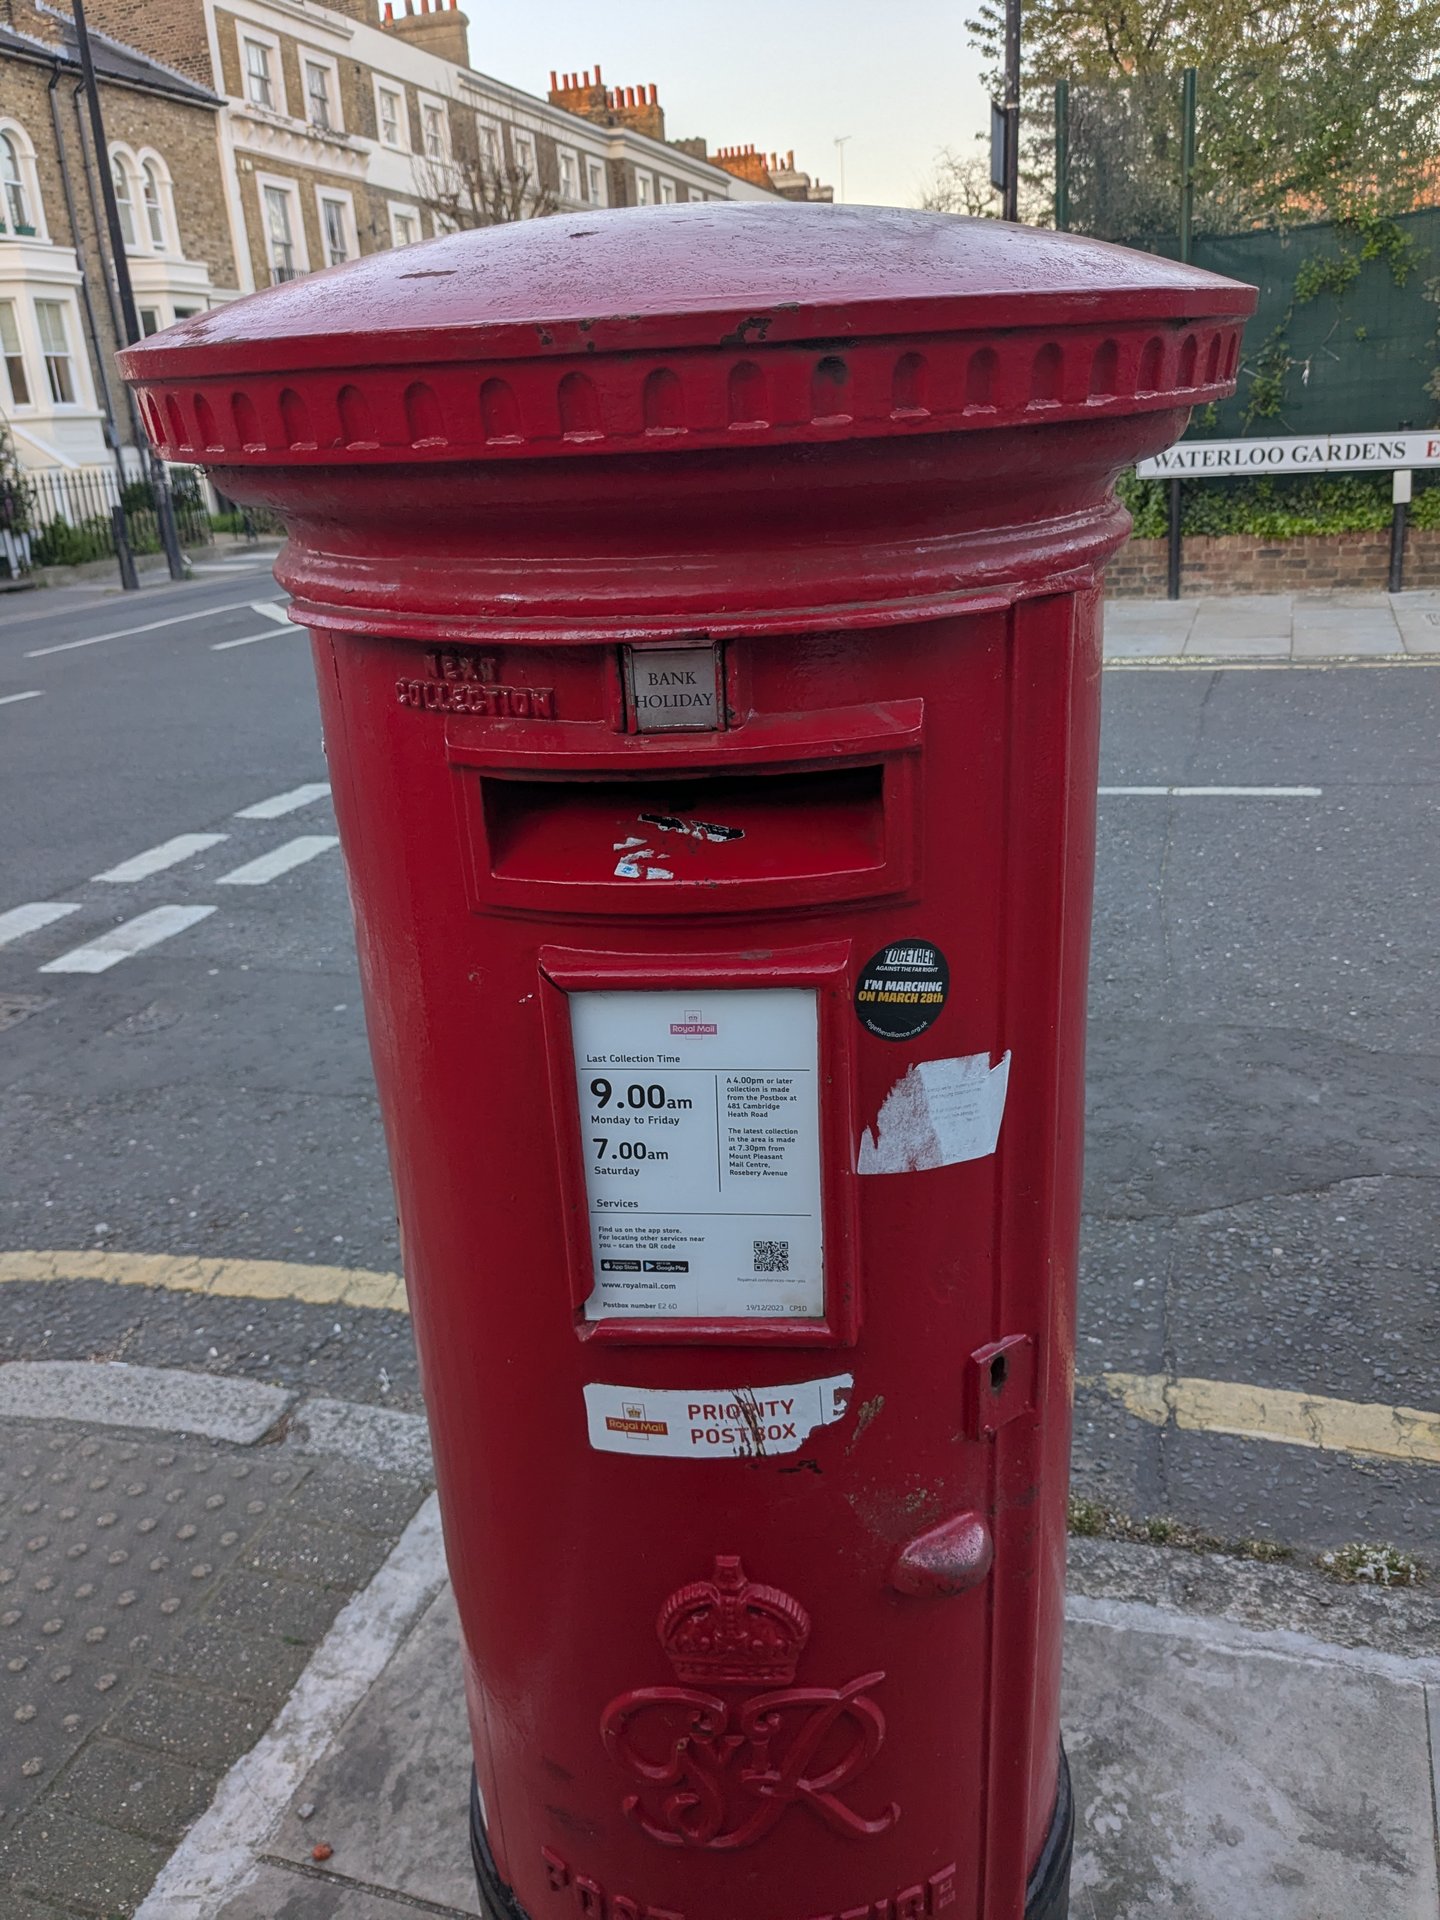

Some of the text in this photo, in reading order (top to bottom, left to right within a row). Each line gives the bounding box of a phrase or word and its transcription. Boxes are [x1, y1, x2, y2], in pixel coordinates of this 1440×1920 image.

[1154, 446, 1284, 469] WATERLOO
[1292, 441, 1406, 463] GARDENS
[648, 671, 697, 686] BANK
[395, 677, 555, 720] COLLECTION
[635, 693, 713, 708] HOLIDAY
[884, 947, 935, 966] TOGETHER
[864, 979, 943, 992] I'M MARCHING
[858, 990, 943, 1003] ON MARCH 28th
[672, 1025, 715, 1034] Royal Mail
[586, 1054, 680, 1063] Last Collection Time
[733, 1076, 764, 1085] 4.00pm
[590, 1078, 693, 1109] 9.00am
[742, 1103, 780, 1111] Cambridge
[591, 1115, 680, 1126] Monday to Friday
[592, 1138, 669, 1160] 7.00am
[737, 1144, 766, 1152] 7.30pm
[745, 1161, 771, 1169] Centre,
[594, 1166, 640, 1177] Saturday
[729, 1169, 761, 1177] Rosebery
[596, 1198, 639, 1208] Services
[611, 1234, 639, 1242] locating
[601, 1282, 676, 1290] www.royalmail.com
[609, 1419, 664, 1432] Royal Mail
